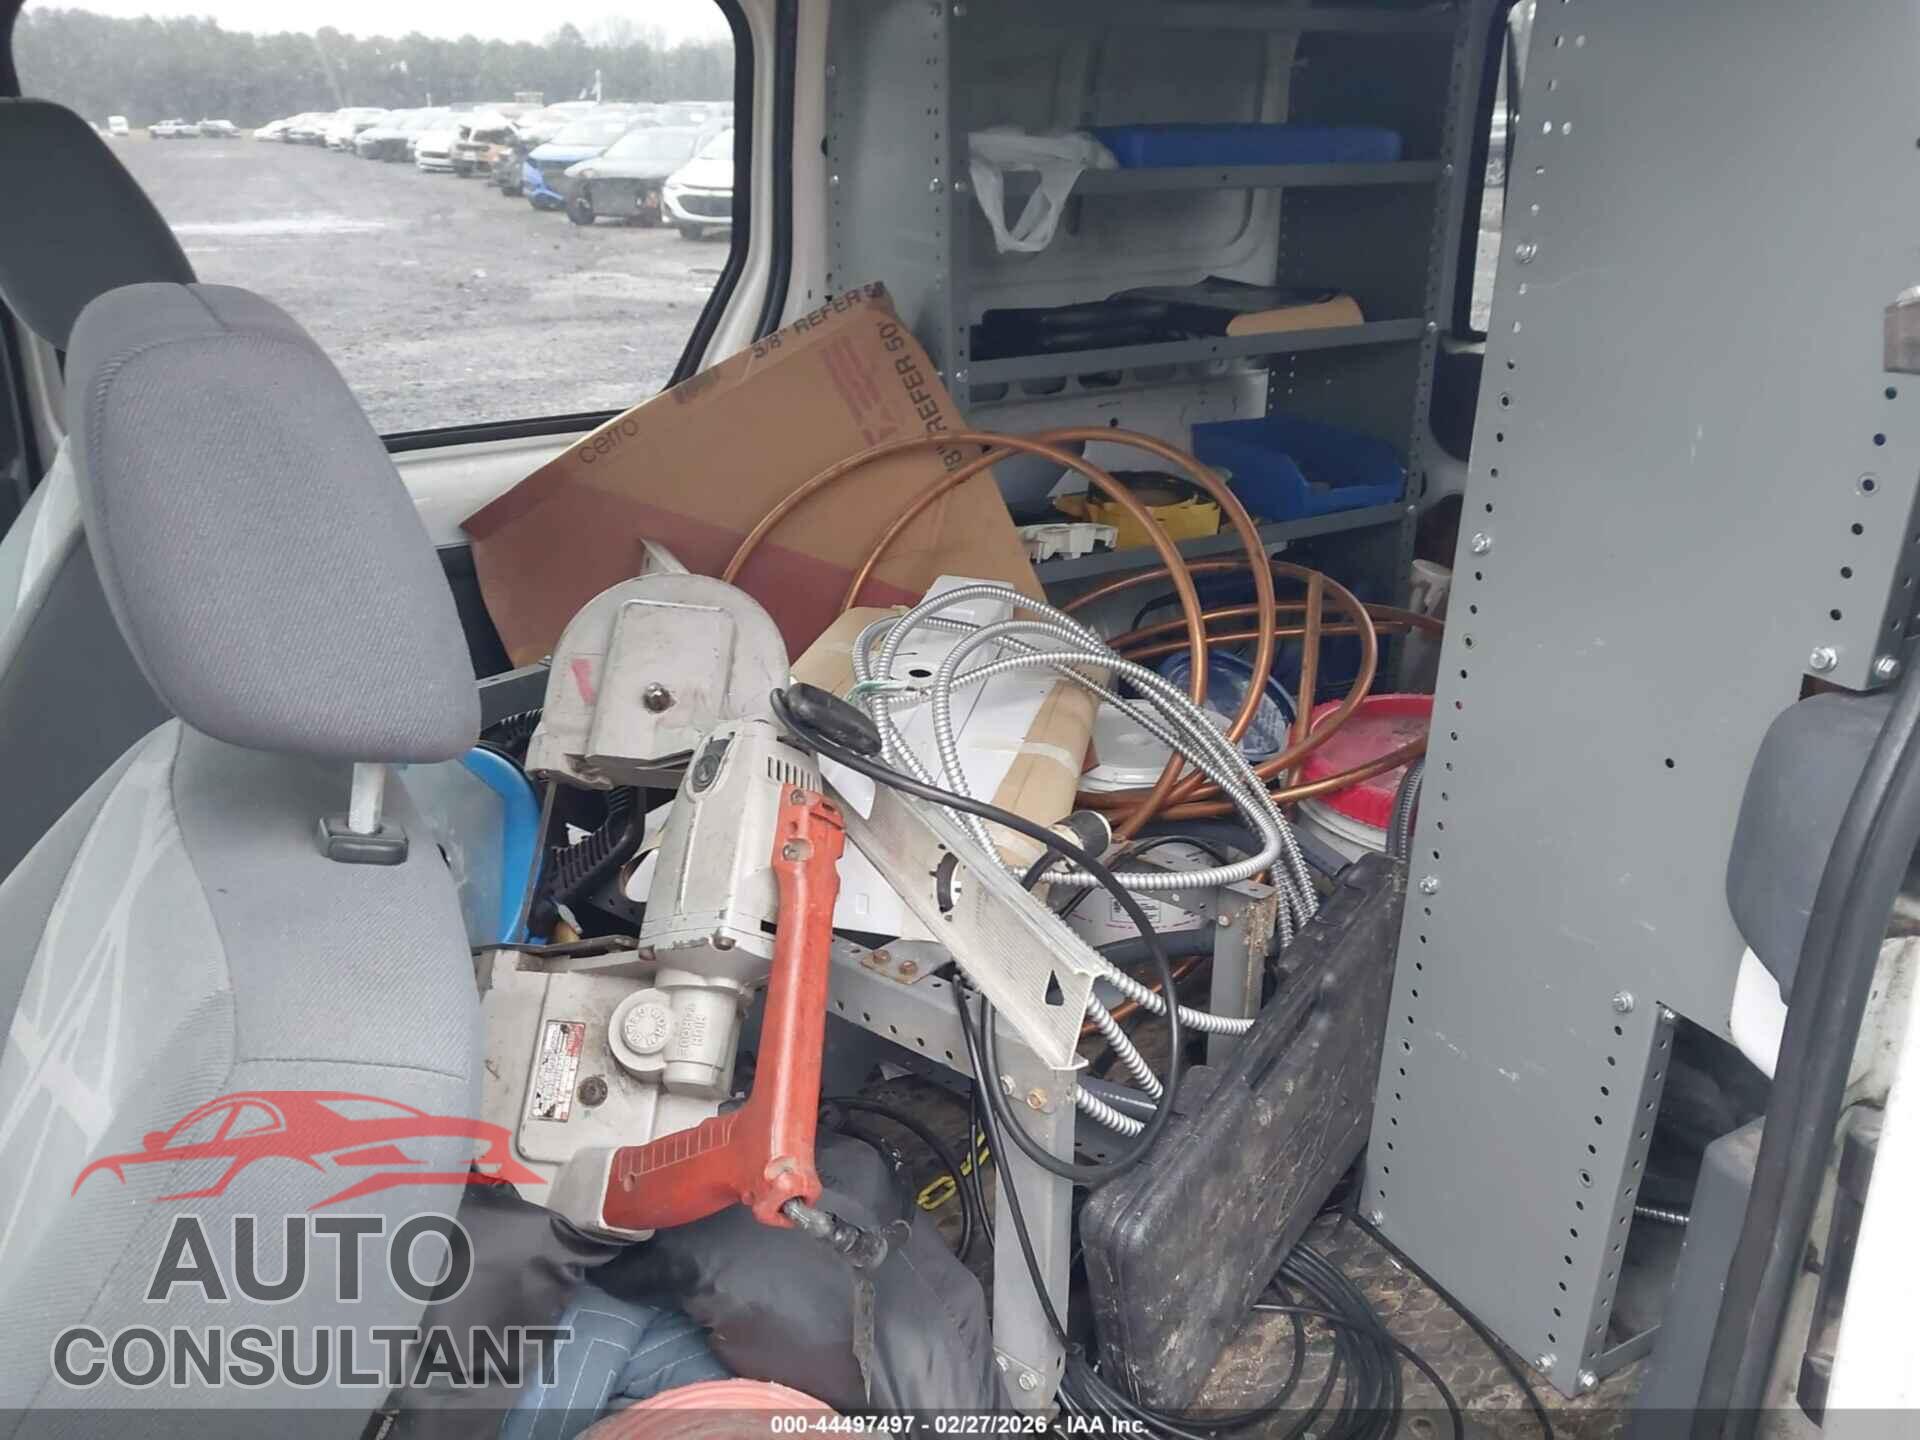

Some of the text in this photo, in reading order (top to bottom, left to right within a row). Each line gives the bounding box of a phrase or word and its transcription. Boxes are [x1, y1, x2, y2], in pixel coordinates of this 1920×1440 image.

[793, 287, 862, 334] REFER
[895, 354, 947, 435] REFER
[579, 418, 638, 464] cerro
